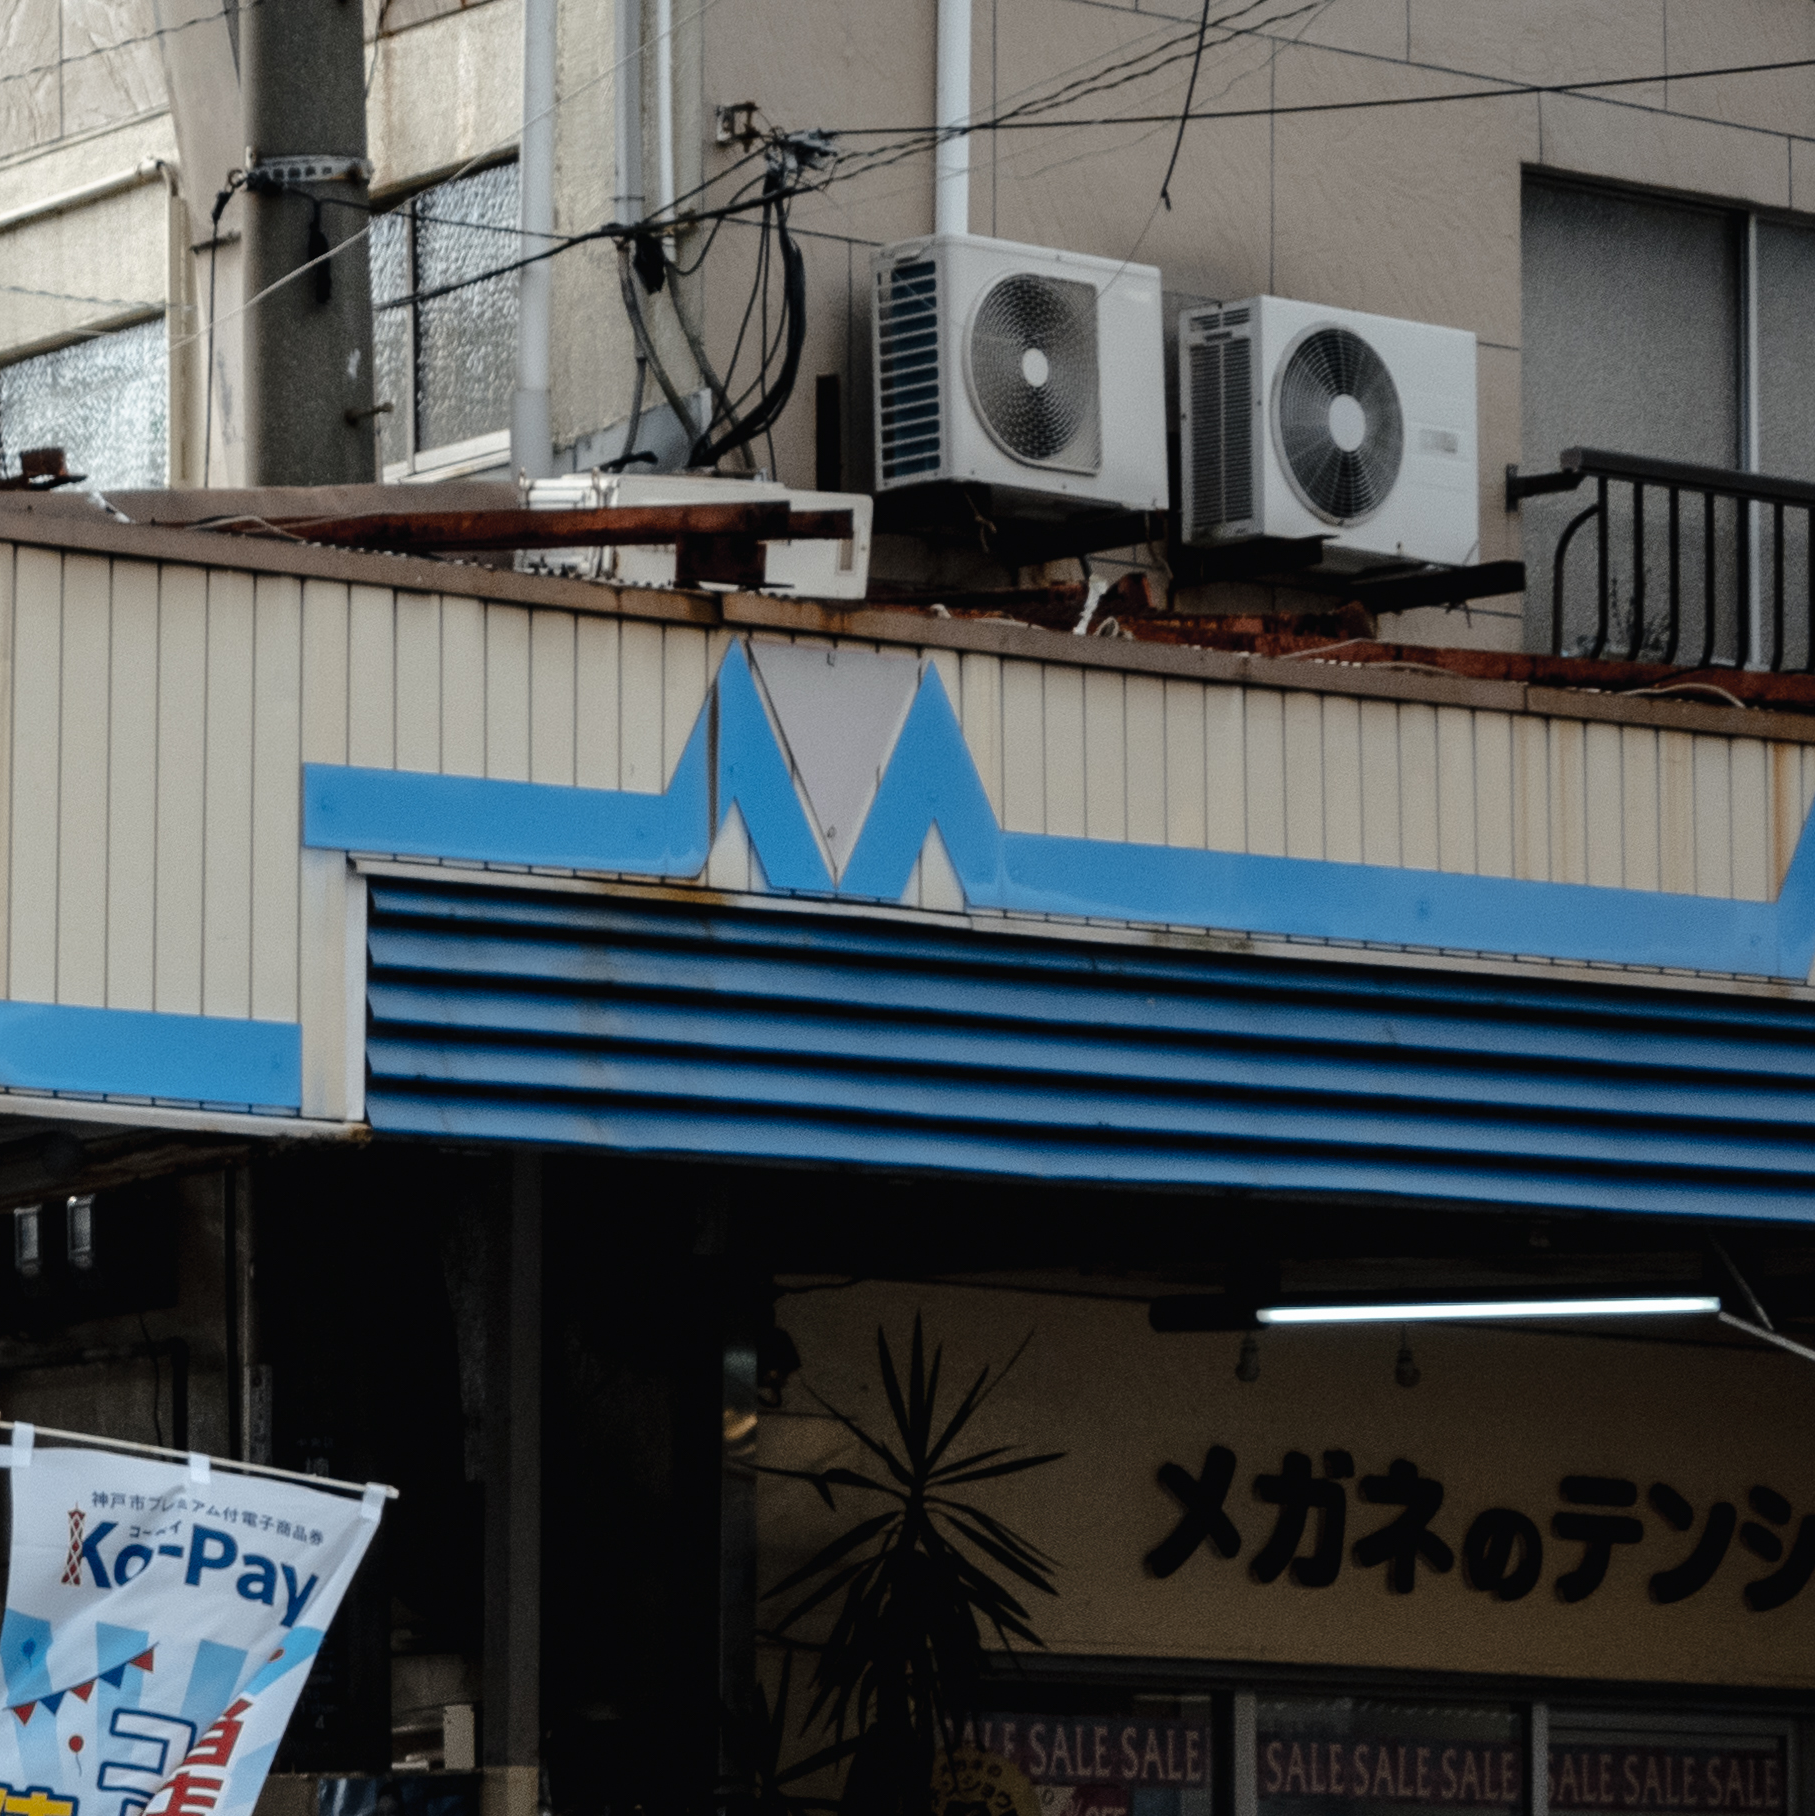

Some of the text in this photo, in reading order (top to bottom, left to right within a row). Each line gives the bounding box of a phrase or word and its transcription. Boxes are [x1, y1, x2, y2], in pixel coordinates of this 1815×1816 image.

[63, 1512, 319, 1629] Ko-Pay
[1028, 1721, 1112, 1779] SALE
[1120, 1726, 1203, 1783] SALE
[1265, 1741, 1519, 1802] SALE SALE SALE
[1622, 1753, 1699, 1806] SALE
[1705, 1755, 1782, 1809] SALE
